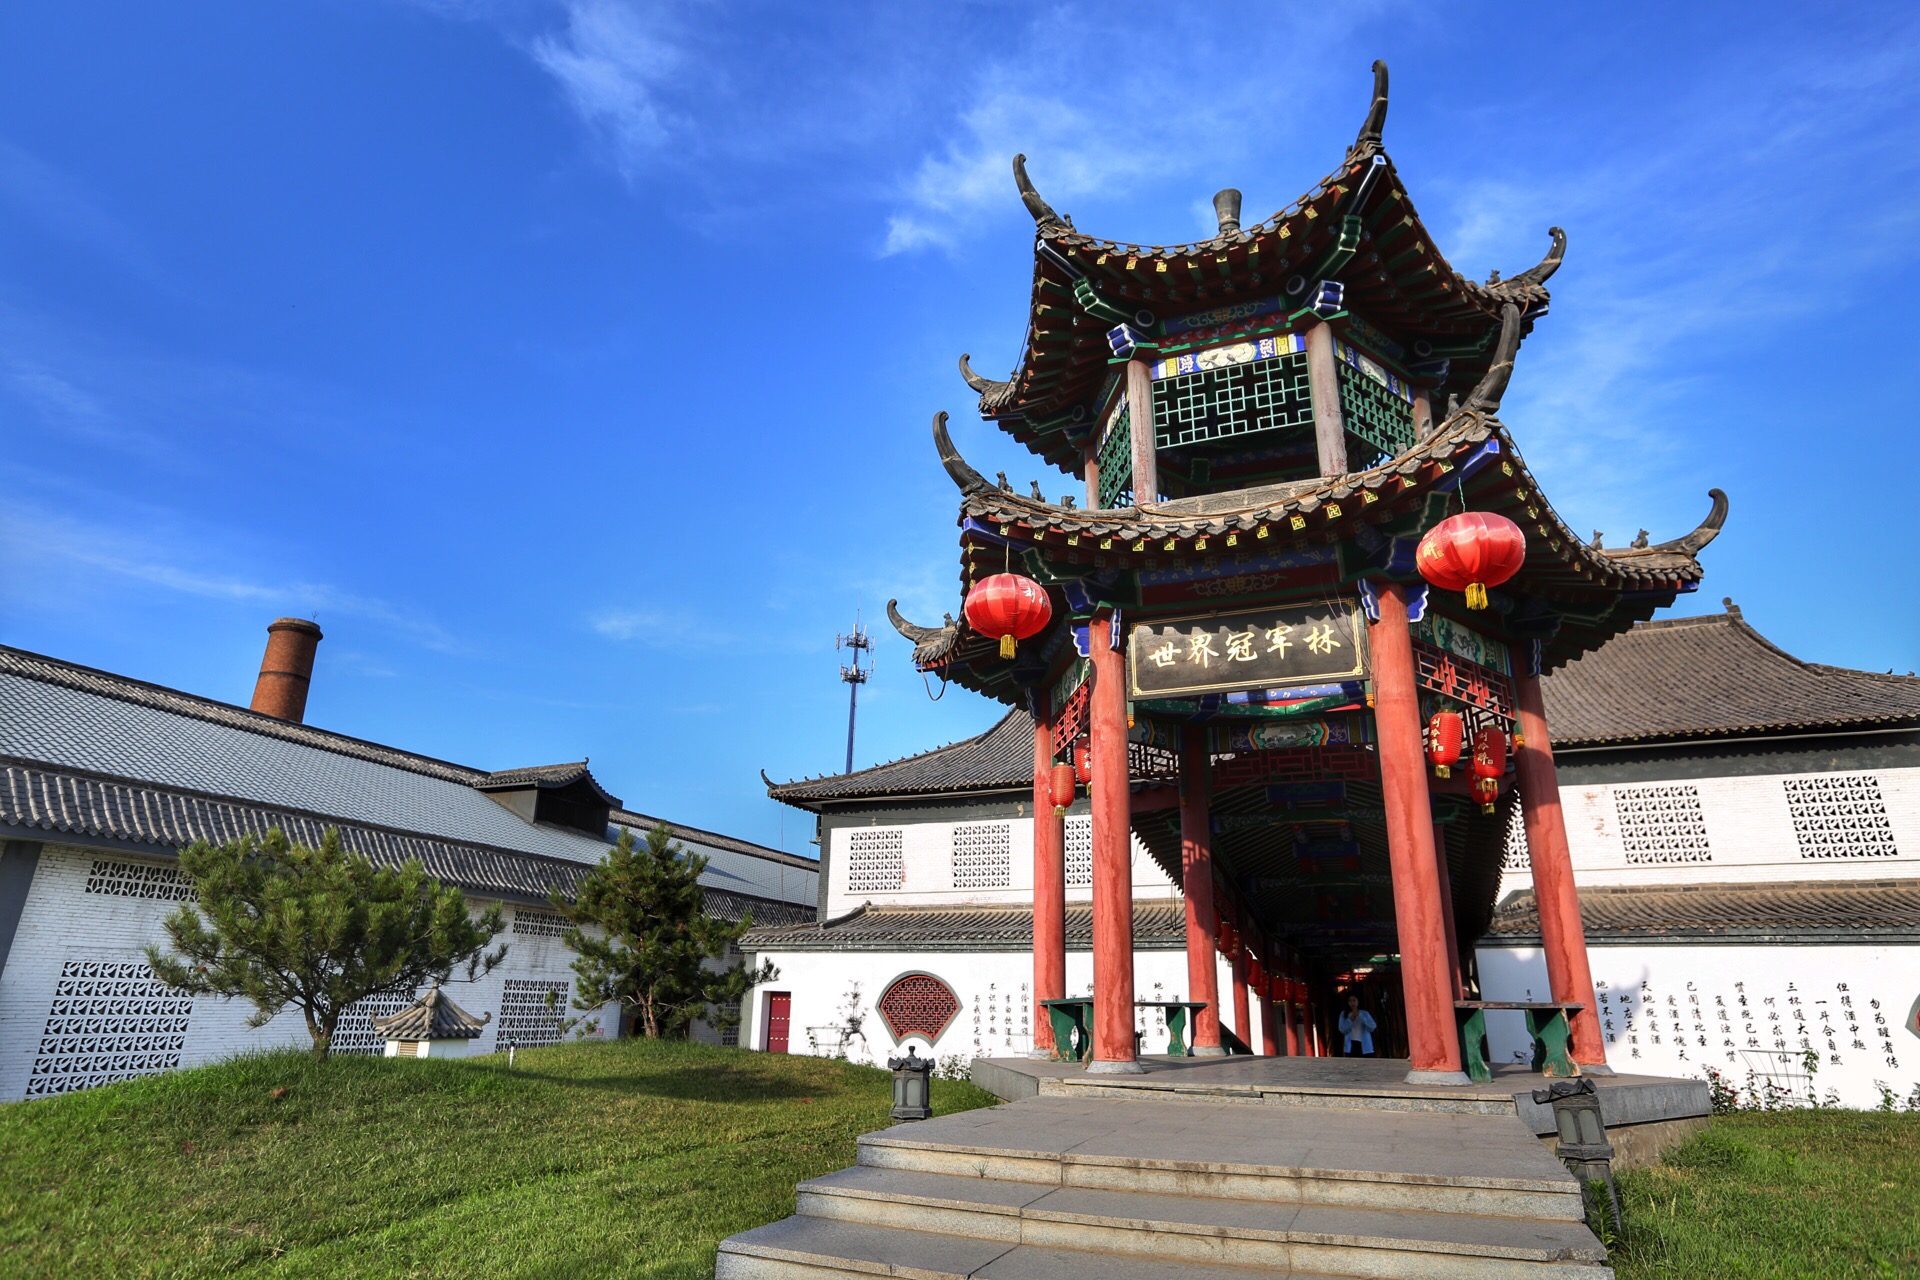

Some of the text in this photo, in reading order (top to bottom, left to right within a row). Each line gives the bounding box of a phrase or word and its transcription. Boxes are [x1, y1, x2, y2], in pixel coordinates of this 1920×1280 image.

[1149, 624, 1341, 669] 世界冠军林
[1596, 980, 1616, 1043] 地若不爱酒
[1619, 994, 1642, 1059] 地应无酒泉
[1641, 980, 1661, 1044] 天地既爱酒
[1666, 994, 1690, 1061] 爱酒不愧天
[1686, 981, 1707, 1047] 已闻清比圣
[1715, 995, 1736, 1063] 复道浊如贤
[1734, 981, 1761, 1048] 贤圣既已饮
[1763, 996, 1791, 1063] 何必求神仙
[1786, 982, 1813, 1050] 三杯通大道
[1814, 1000, 1843, 1066] 一斗合自然
[1836, 982, 1867, 1050] 但得酒中趣
[1869, 998, 1899, 1069] 勿为醒者传
